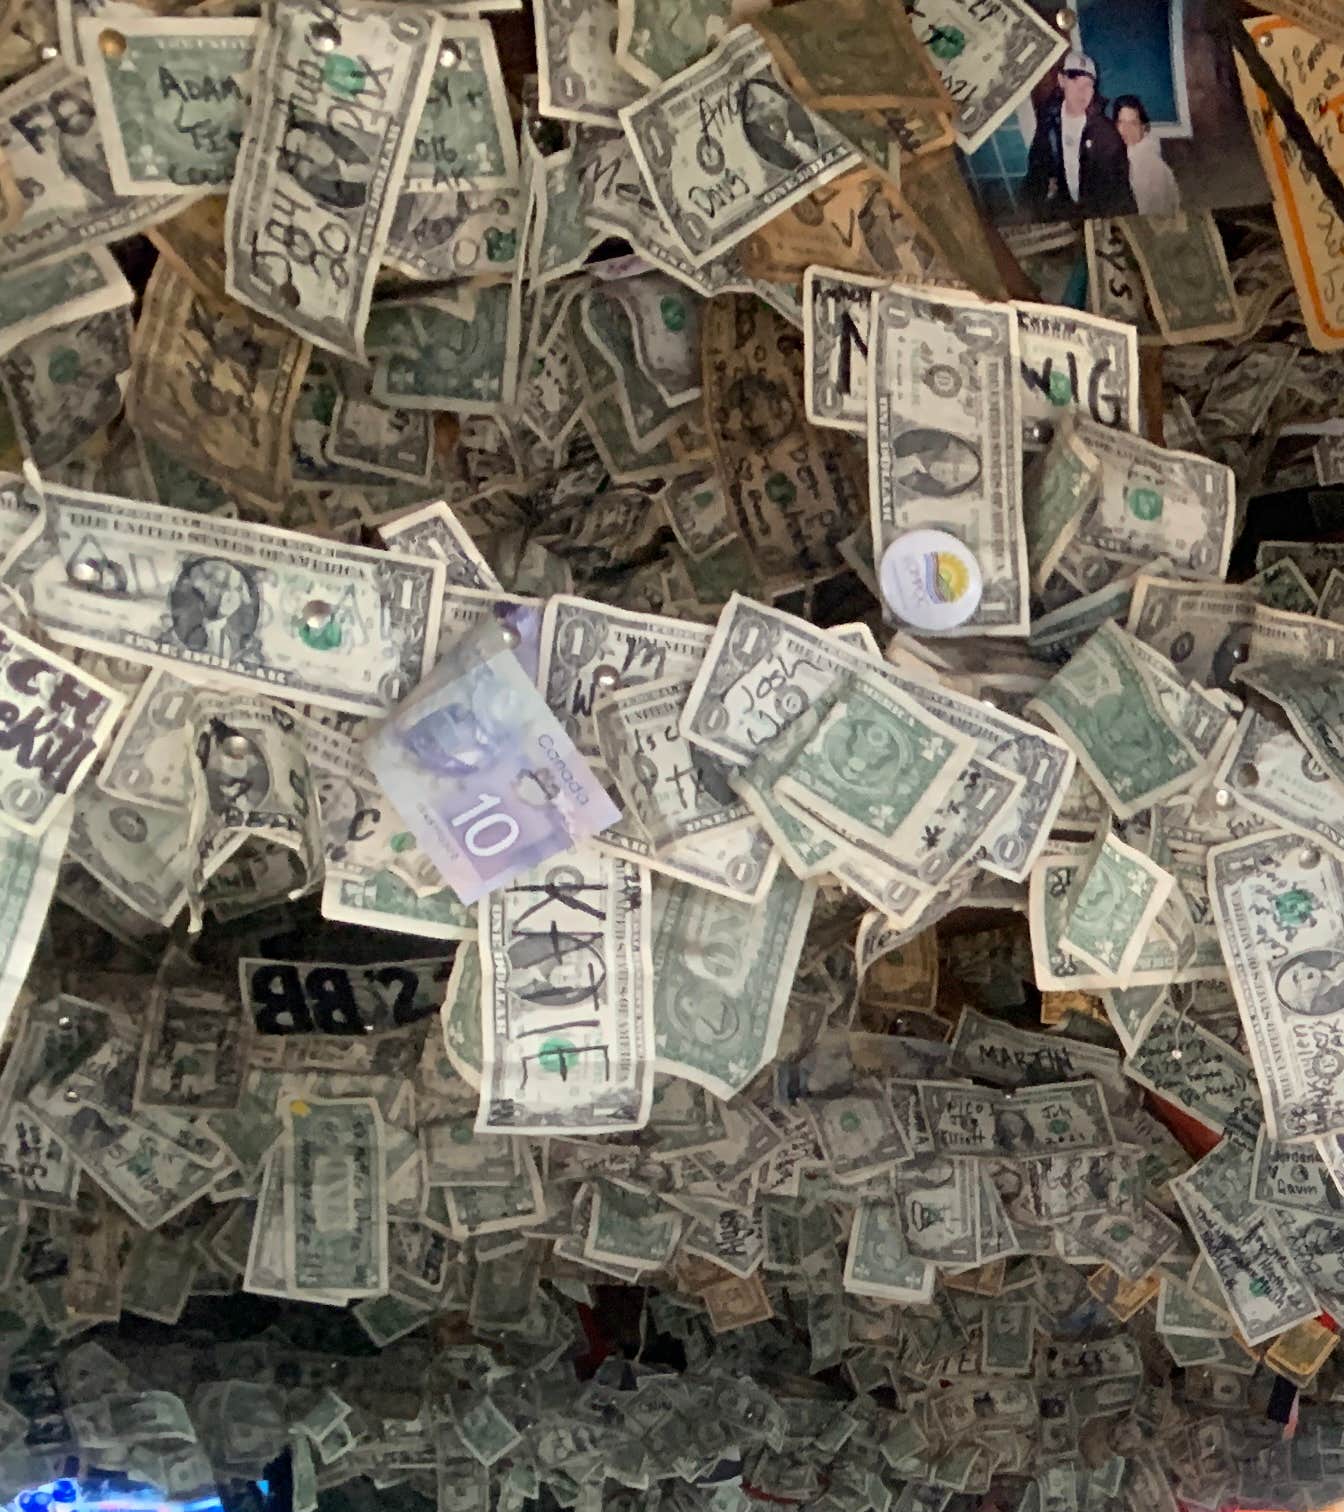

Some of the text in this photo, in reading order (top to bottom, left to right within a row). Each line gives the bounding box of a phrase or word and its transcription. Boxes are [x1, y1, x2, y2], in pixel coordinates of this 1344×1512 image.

[287, 552, 368, 580] AMERICA
[536, 733, 590, 806] Canada
[450, 793, 520, 857] 10
